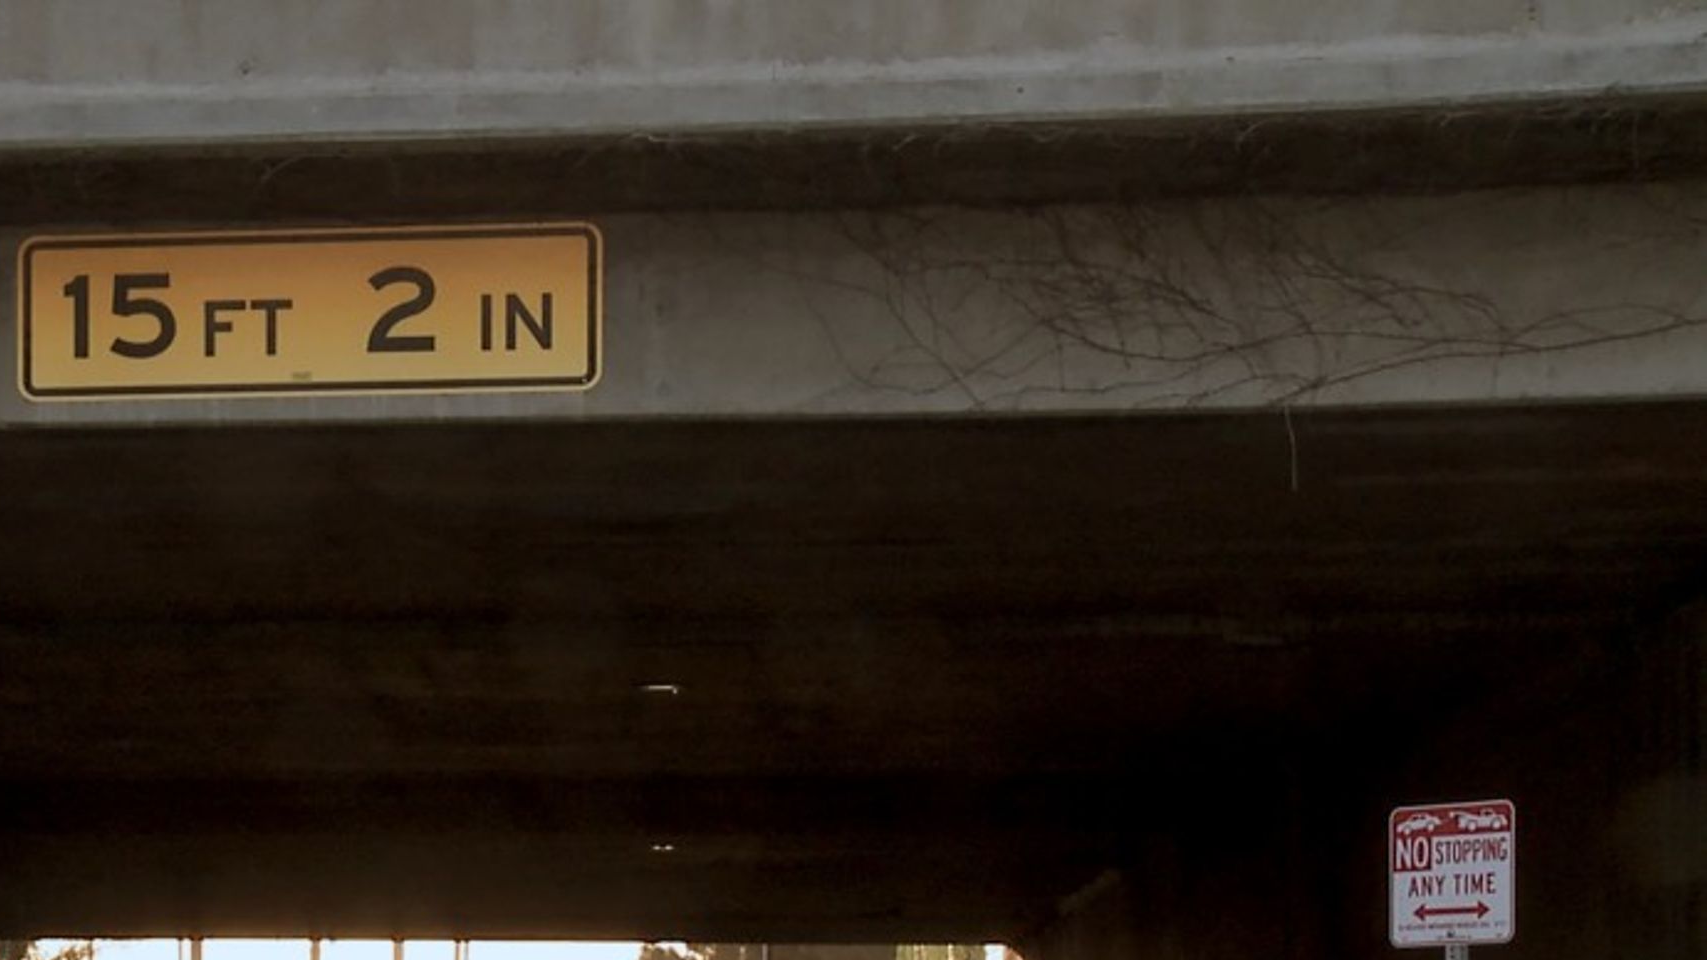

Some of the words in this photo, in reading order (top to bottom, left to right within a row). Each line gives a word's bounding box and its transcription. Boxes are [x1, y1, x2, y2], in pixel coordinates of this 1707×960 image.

[63, 273, 177, 359] 15
[204, 299, 293, 357] FT
[367, 266, 436, 352] 2
[480, 292, 552, 351] IN
[1395, 836, 1430, 870] NO
[1435, 837, 1508, 865] STOPPING
[1408, 874, 1445, 898] ANY
[1453, 872, 1496, 896] TIME
